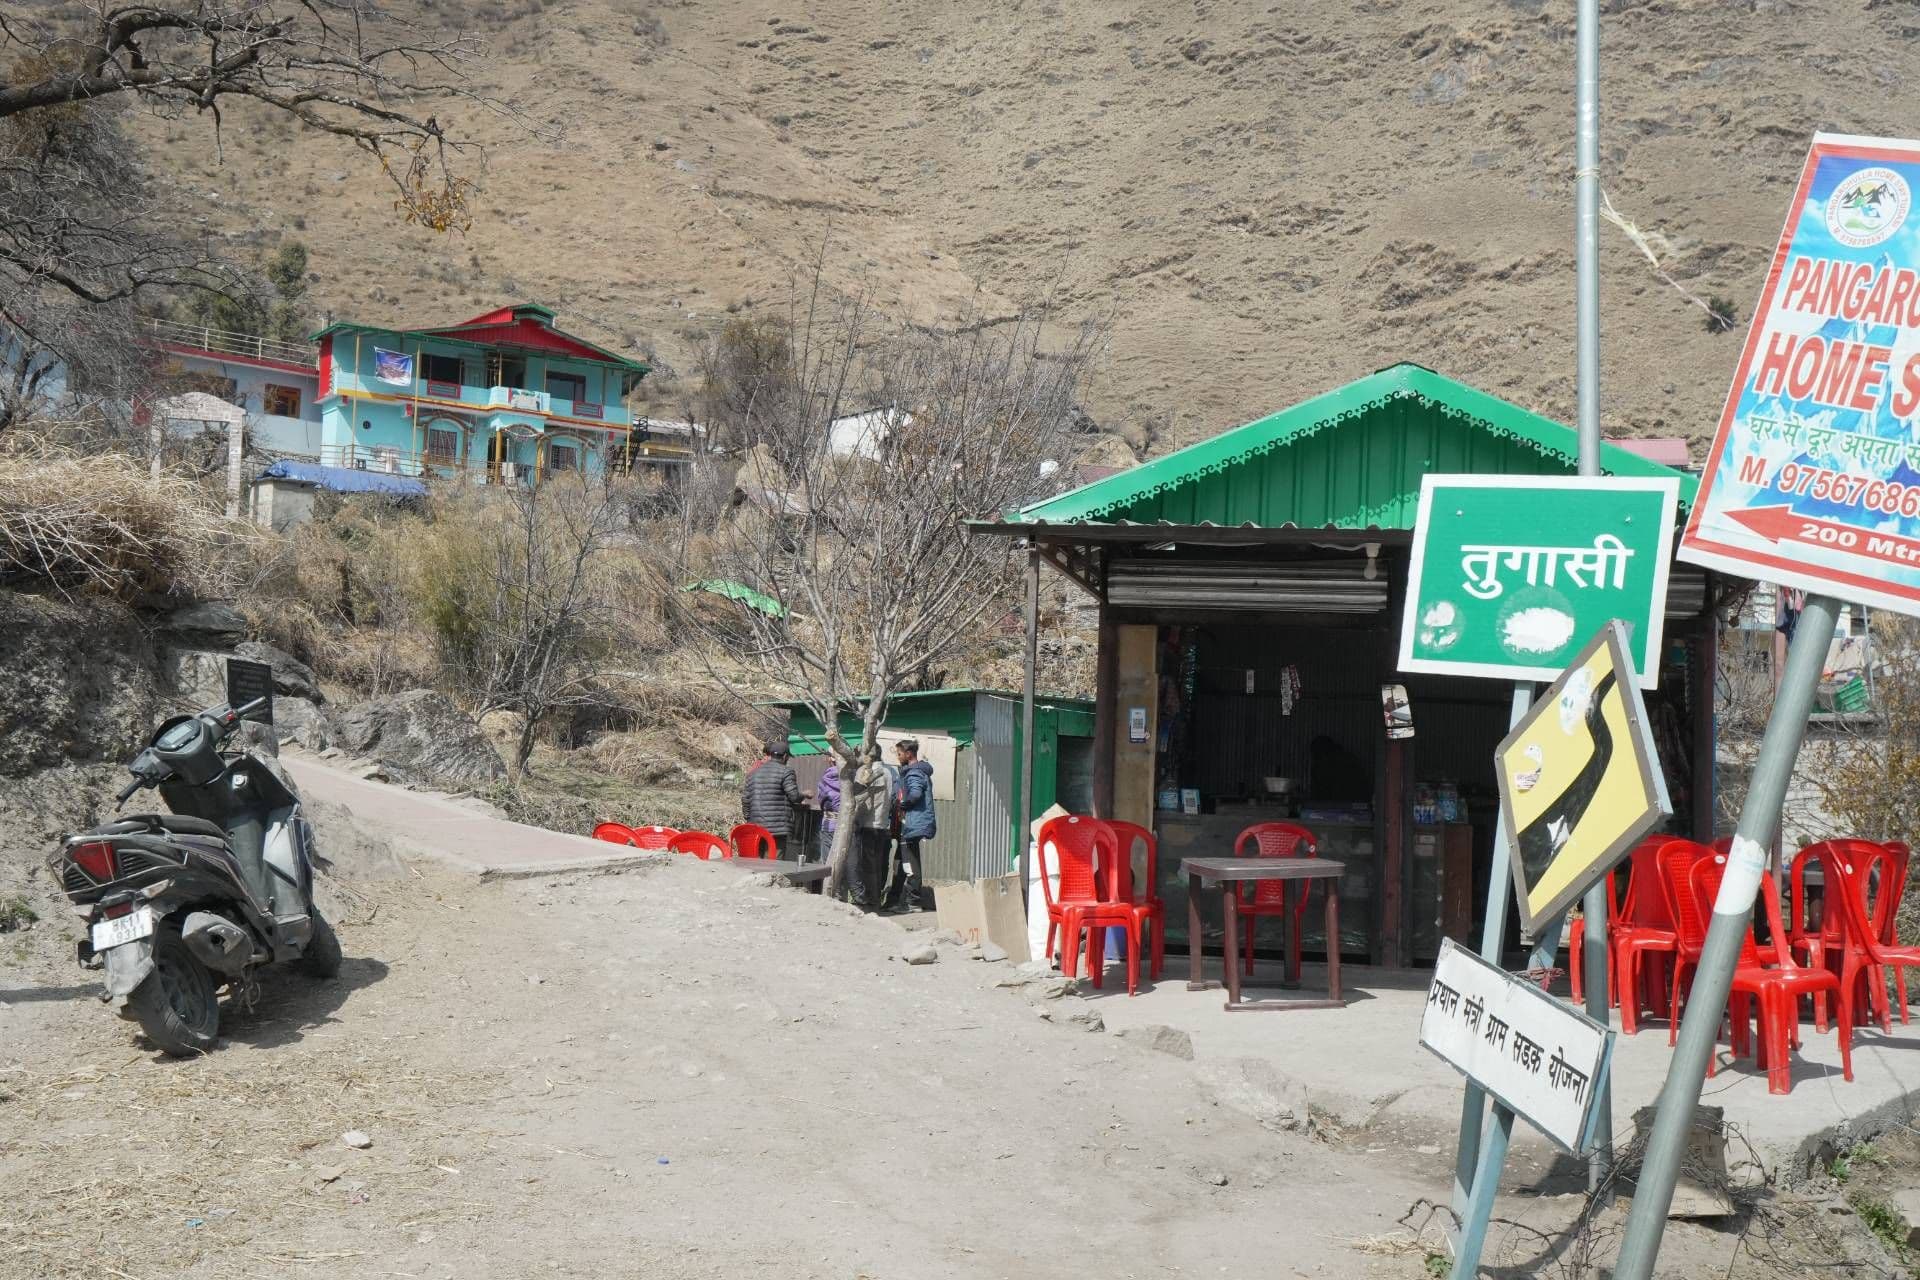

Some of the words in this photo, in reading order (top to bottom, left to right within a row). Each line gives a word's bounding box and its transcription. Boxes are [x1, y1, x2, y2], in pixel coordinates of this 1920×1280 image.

[1755, 332, 1892, 411] HOME
[1751, 417, 1777, 441] घर
[1783, 416, 1801, 447] से
[1808, 428, 1836, 456] दूर
[1739, 455, 1769, 487] M.
[1780, 463, 1920, 516] 97567686
[1460, 533, 1635, 600] तुगासी
[1799, 523, 1857, 547] 200
[1429, 979, 1461, 1019] प्रधान
[1463, 993, 1484, 1035] मंत्री
[1484, 1013, 1509, 1052] ग्राम
[1513, 1030, 1545, 1075] सड़क
[1548, 1046, 1589, 1106] योजना
